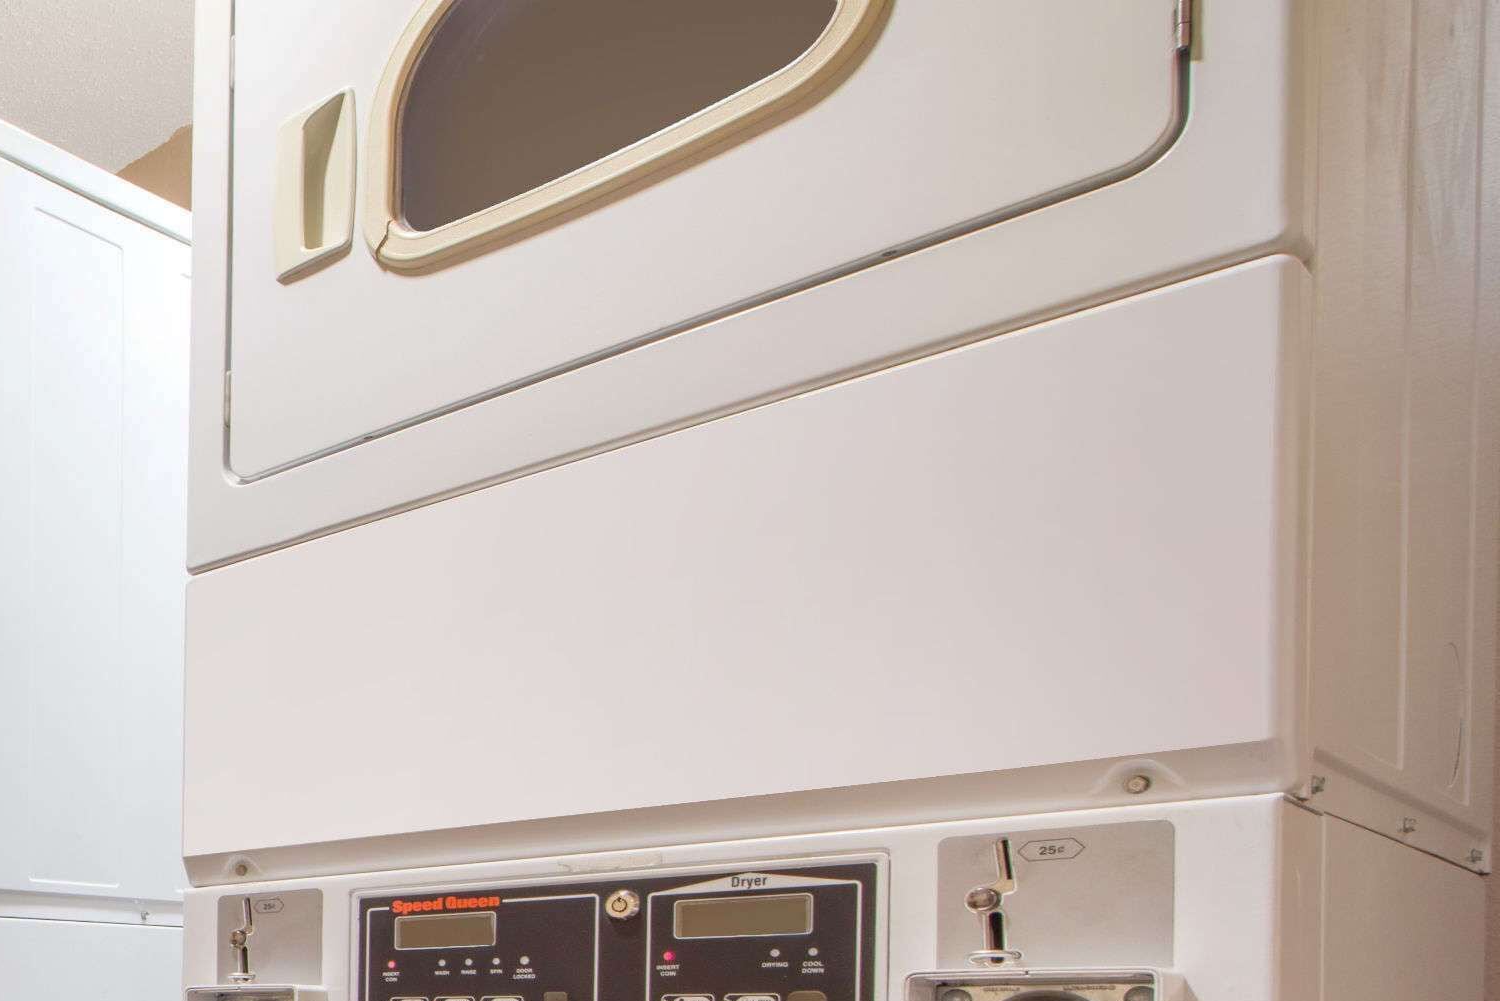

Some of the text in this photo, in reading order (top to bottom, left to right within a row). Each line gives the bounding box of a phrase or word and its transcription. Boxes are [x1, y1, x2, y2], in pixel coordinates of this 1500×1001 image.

[731, 876, 768, 889] Dryer
[392, 896, 500, 915] Speed Queen
